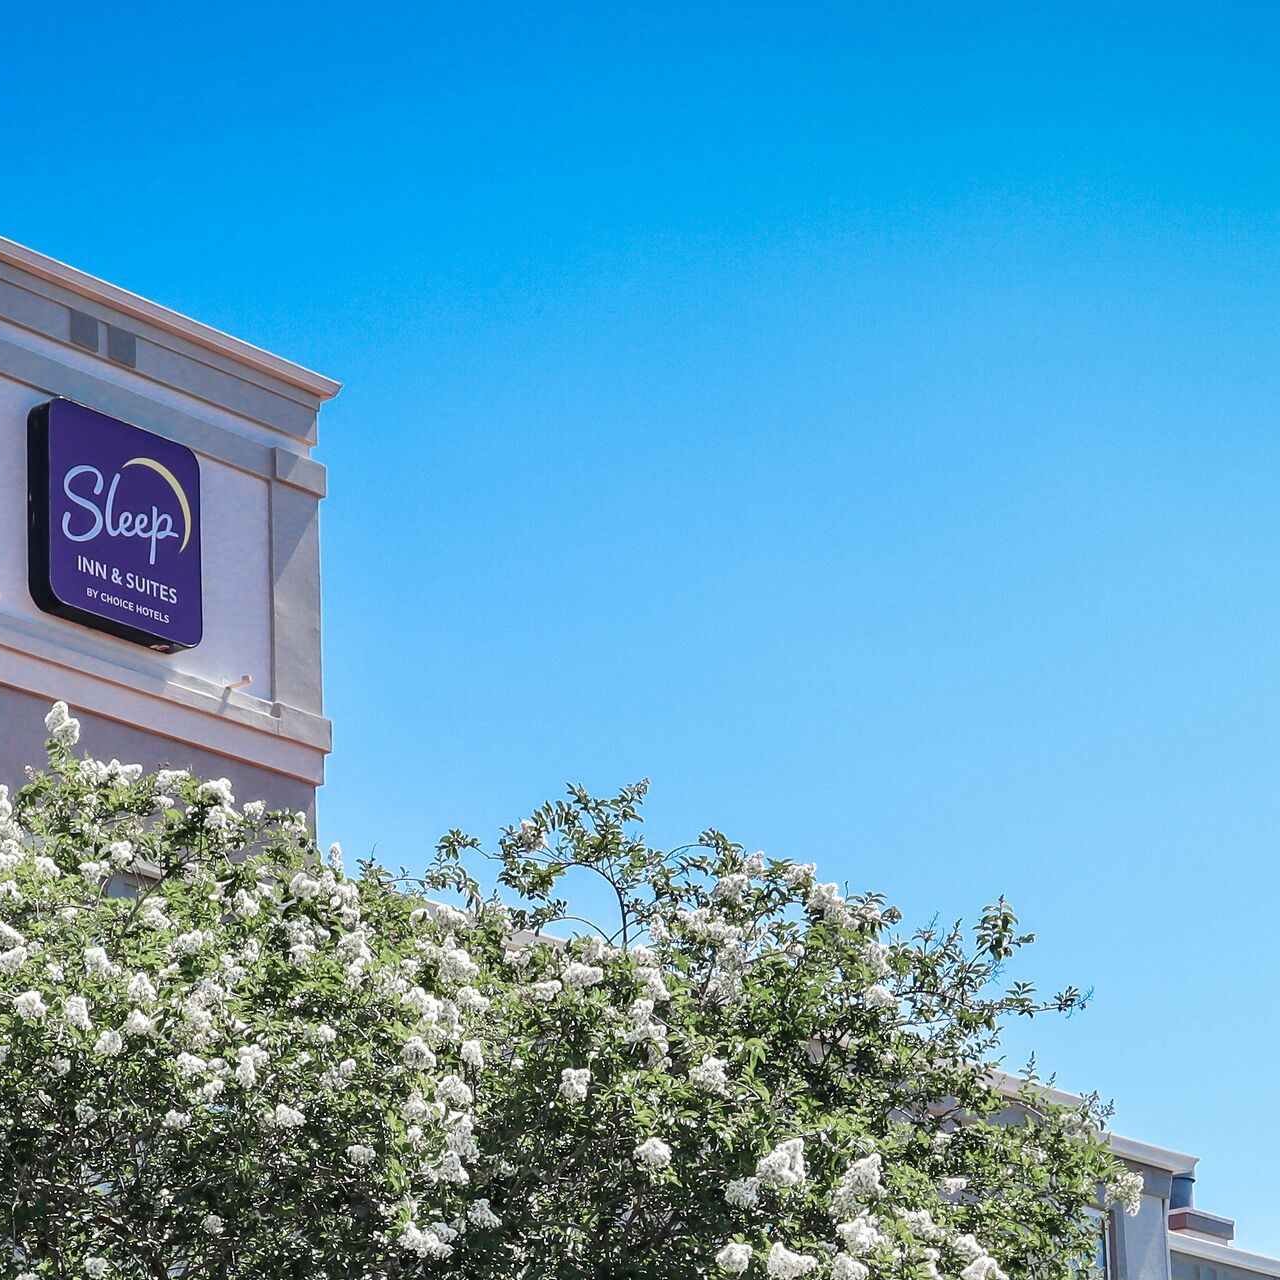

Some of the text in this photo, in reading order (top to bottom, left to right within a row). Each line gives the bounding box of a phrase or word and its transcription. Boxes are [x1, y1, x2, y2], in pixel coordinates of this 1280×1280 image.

[61, 464, 180, 565] Sleep
[77, 554, 178, 604] INN & SUITES
[86, 587, 170, 624] BY CHOICE HOTELS
